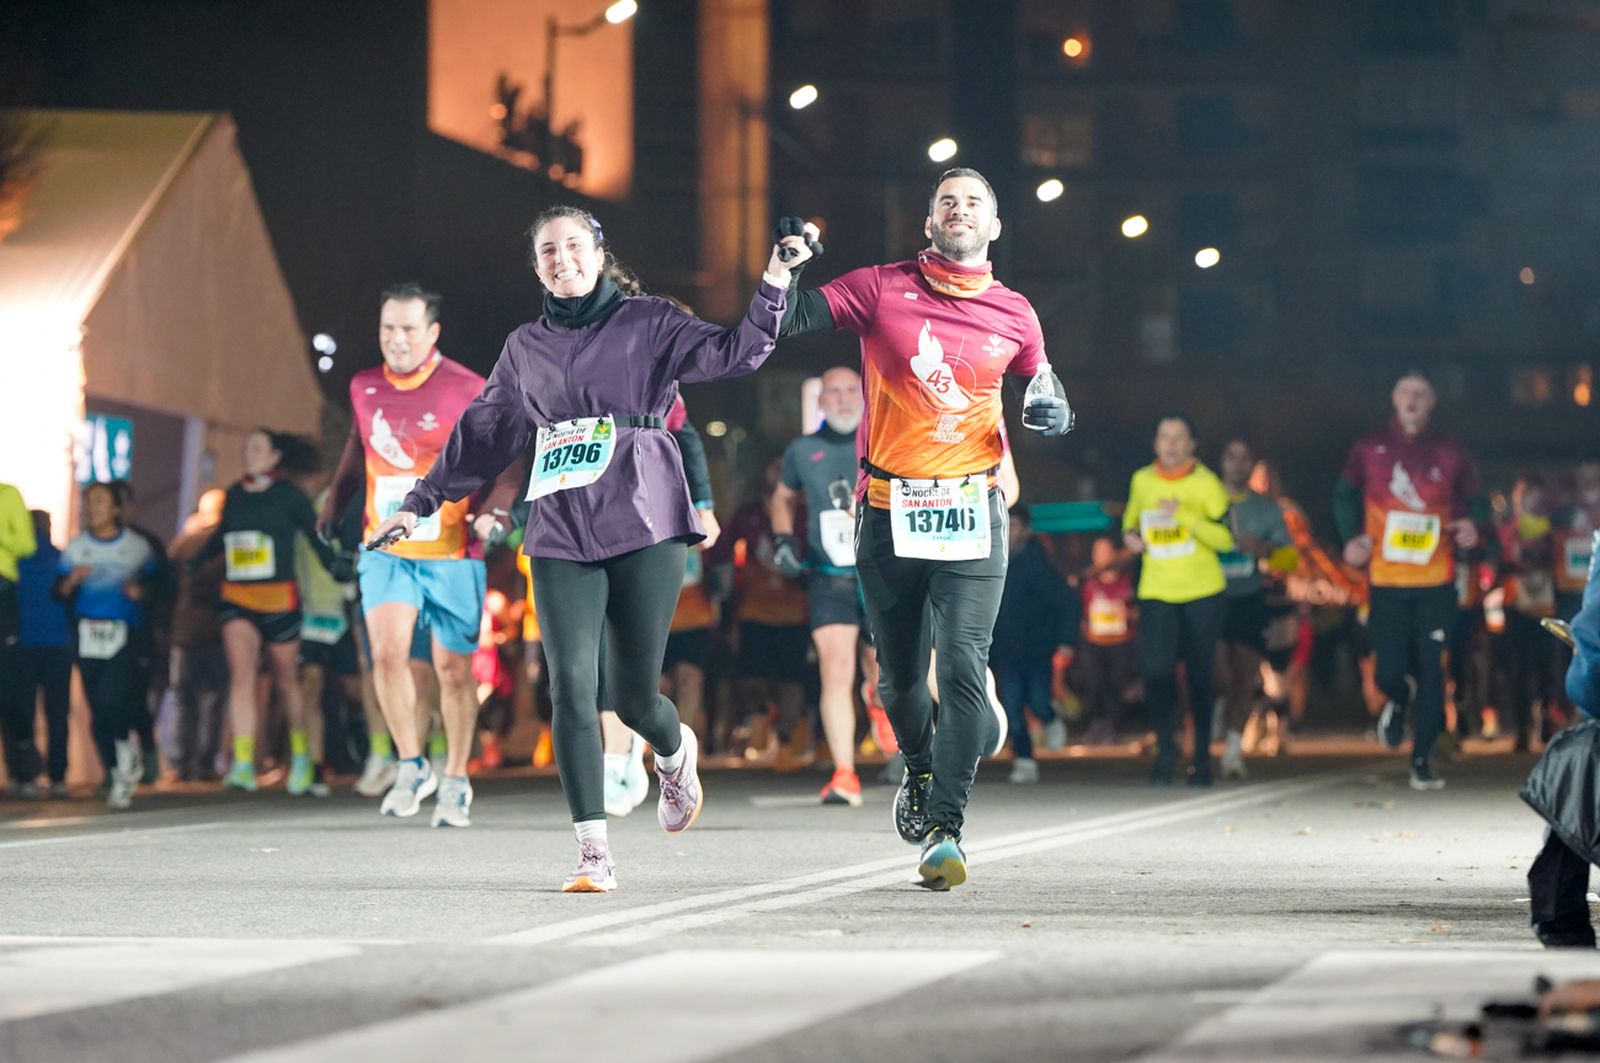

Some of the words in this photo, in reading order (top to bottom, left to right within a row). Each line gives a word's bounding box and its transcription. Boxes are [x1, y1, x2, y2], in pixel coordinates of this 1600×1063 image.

[926, 369, 952, 393] 43
[544, 440, 557, 450] SAN
[542, 442, 602, 473] 13796
[902, 499, 920, 508] SAN
[905, 507, 976, 533] 13746
